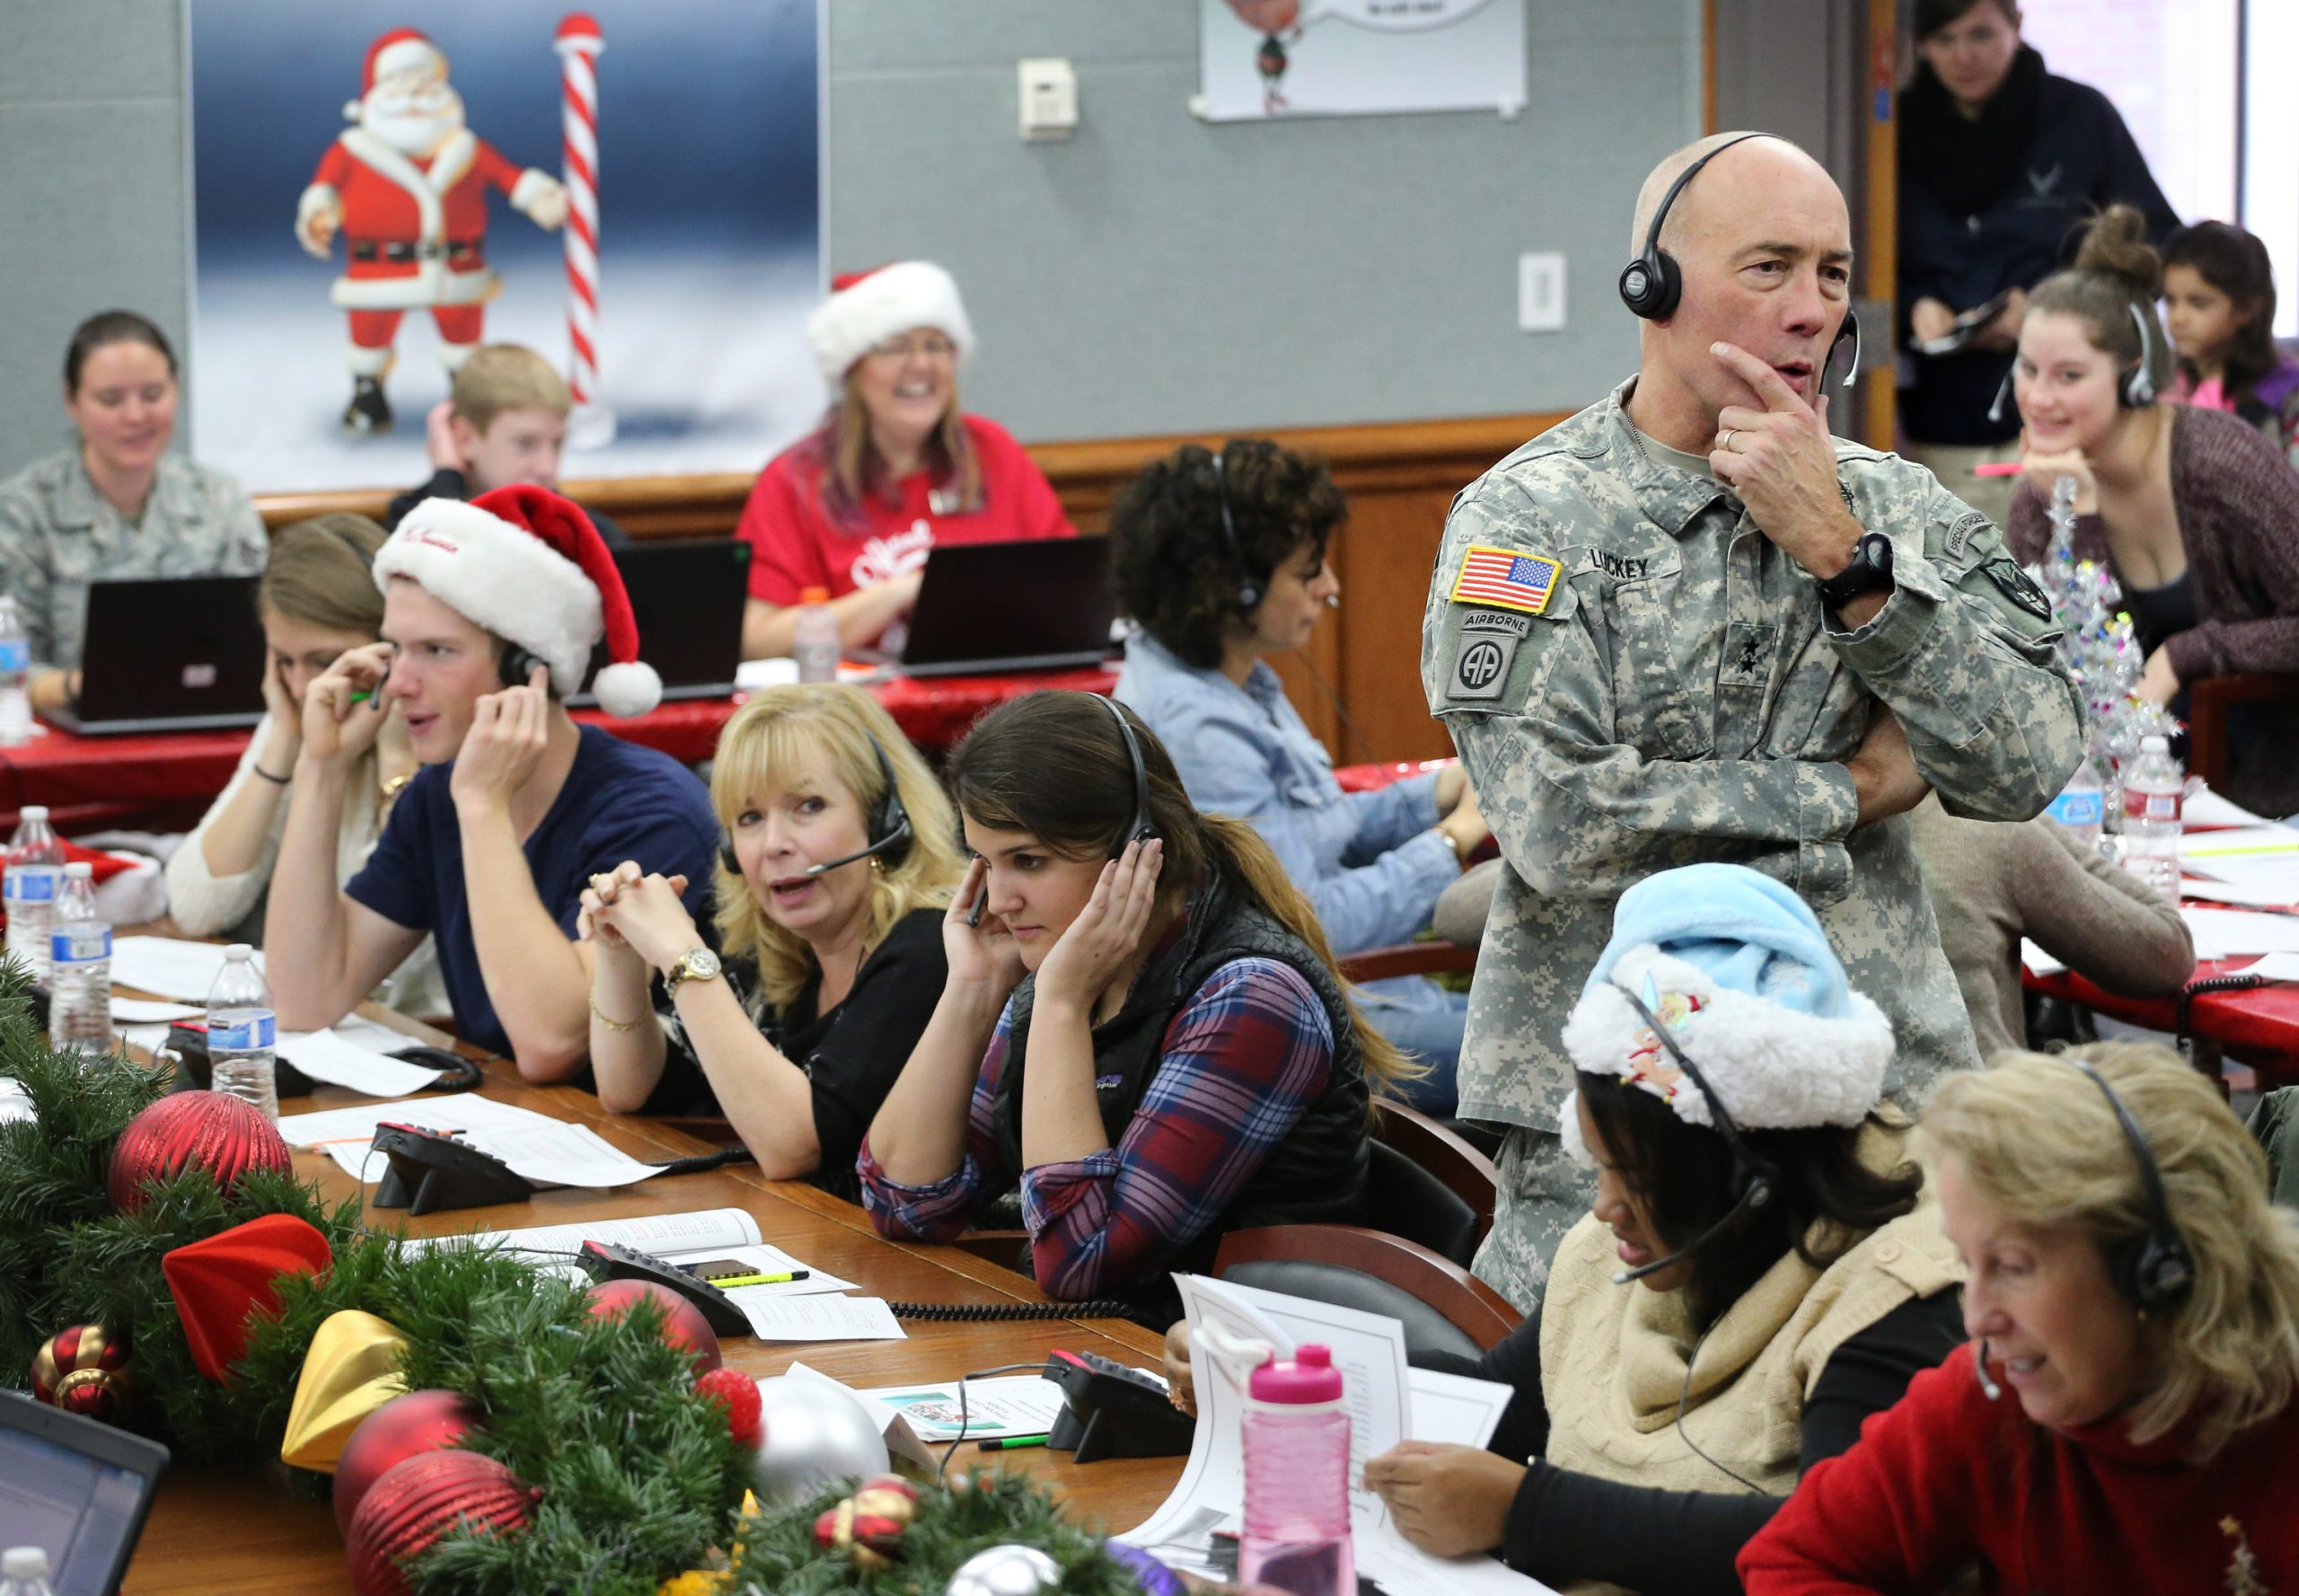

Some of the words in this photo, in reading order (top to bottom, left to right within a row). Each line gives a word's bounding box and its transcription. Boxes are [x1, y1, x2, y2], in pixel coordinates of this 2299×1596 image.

[1950, 525, 1968, 551] SPECIAL
[1961, 514, 1985, 526] FORCES
[1590, 548, 1648, 579] LUCKEY
[1465, 613, 1526, 632] AIRBORNE
